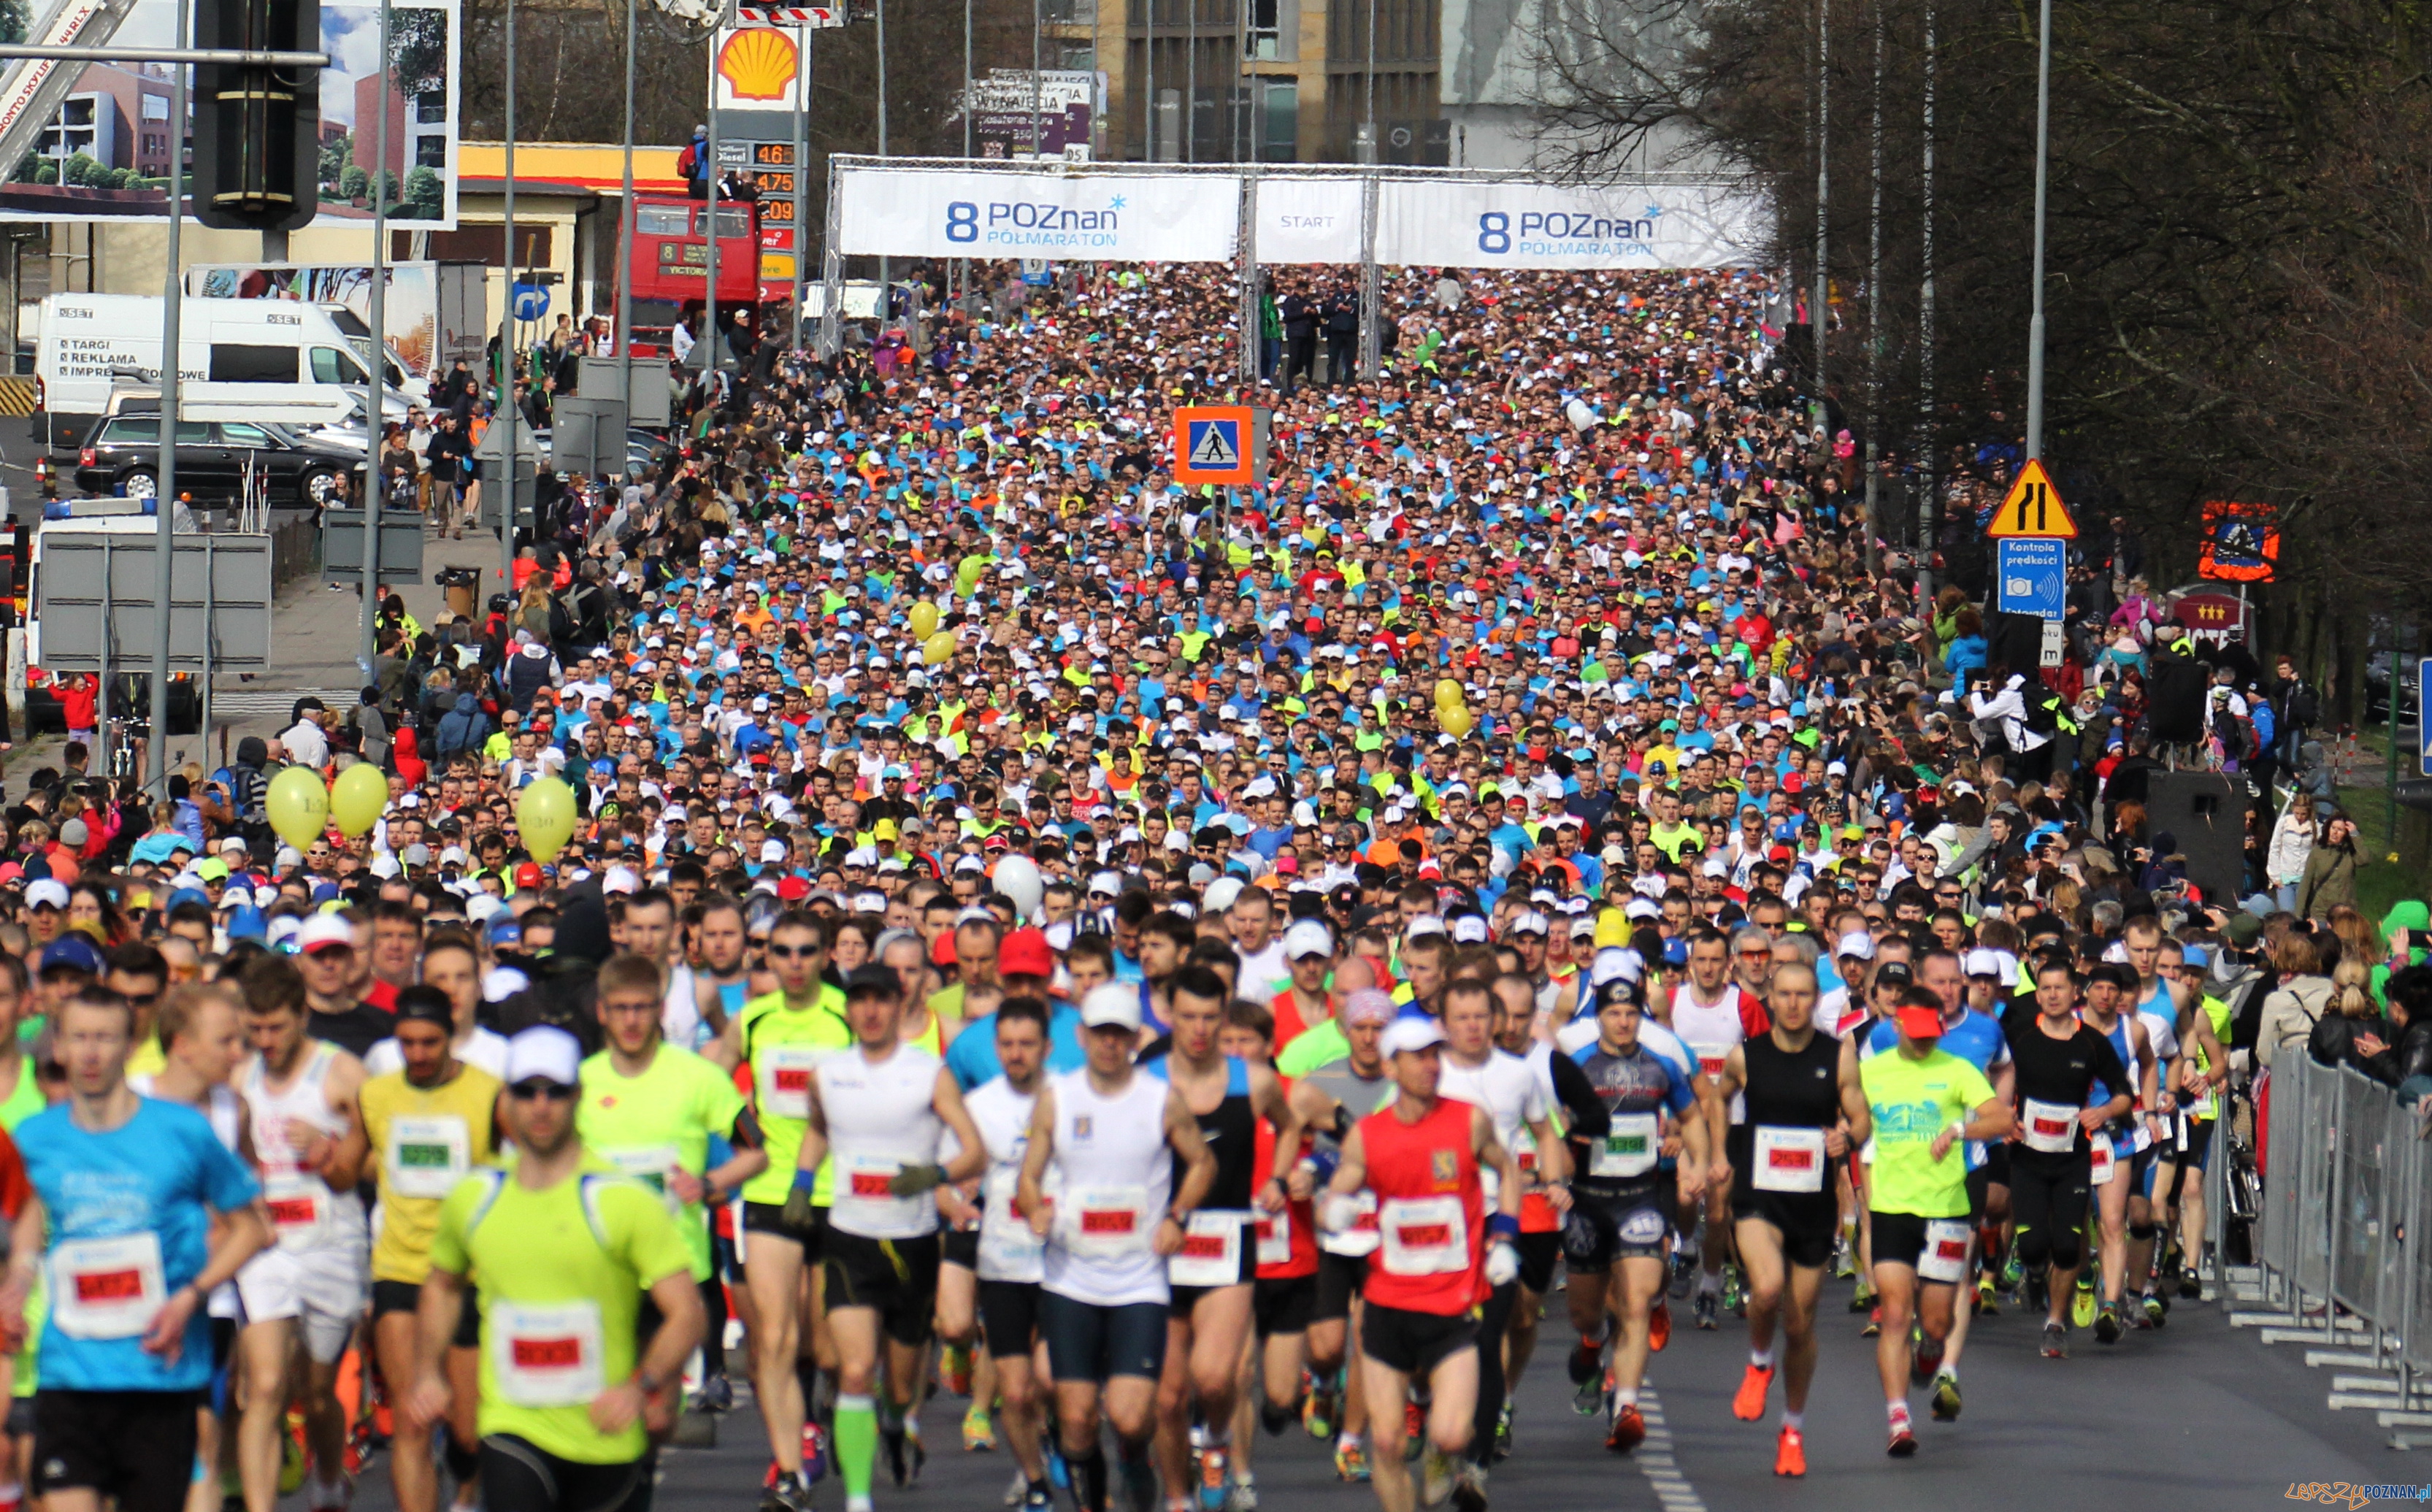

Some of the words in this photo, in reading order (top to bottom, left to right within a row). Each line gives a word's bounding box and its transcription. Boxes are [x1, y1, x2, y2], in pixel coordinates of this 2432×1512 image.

[757, 174, 794, 191] 4.75
[945, 201, 979, 243] 8
[1280, 215, 1335, 228] START
[987, 229, 1118, 247] PÓŁMARATON
[1478, 212, 1511, 254] 8
[664, 245, 673, 259] 8
[1519, 239, 1654, 256] PÓŁMARATON
[72, 340, 110, 350] TARGI
[72, 353, 137, 364] REKLAMA
[2009, 542, 2056, 552] Kontrola
[2007, 555, 2058, 568] prędkości
